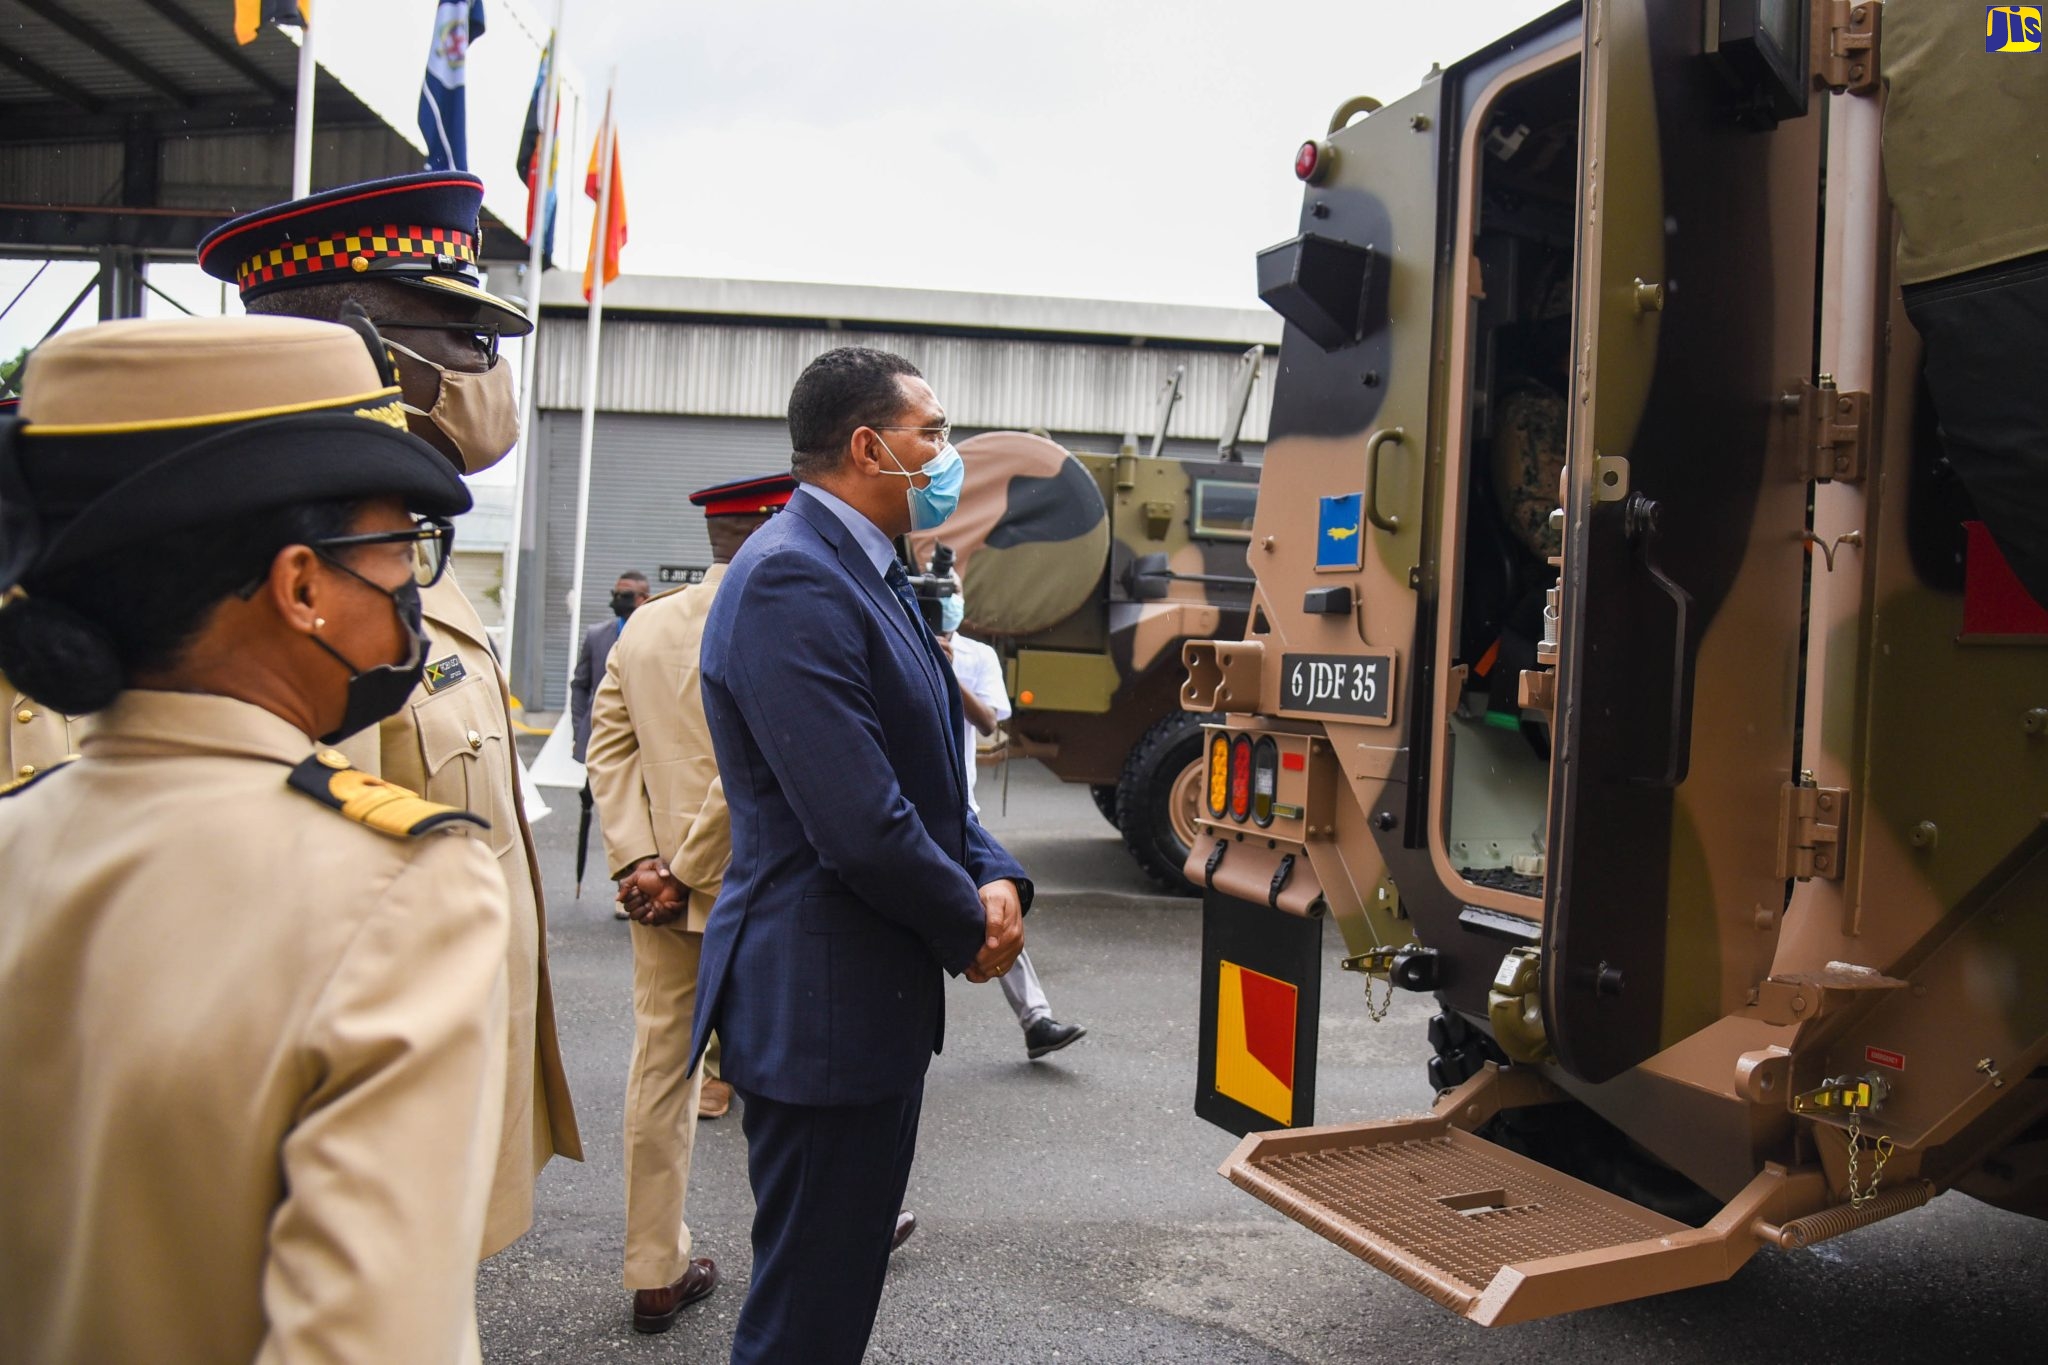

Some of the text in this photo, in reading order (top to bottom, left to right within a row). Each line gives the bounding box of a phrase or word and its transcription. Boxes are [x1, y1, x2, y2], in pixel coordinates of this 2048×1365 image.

[1291, 661, 1377, 706] 6 JDF 35
